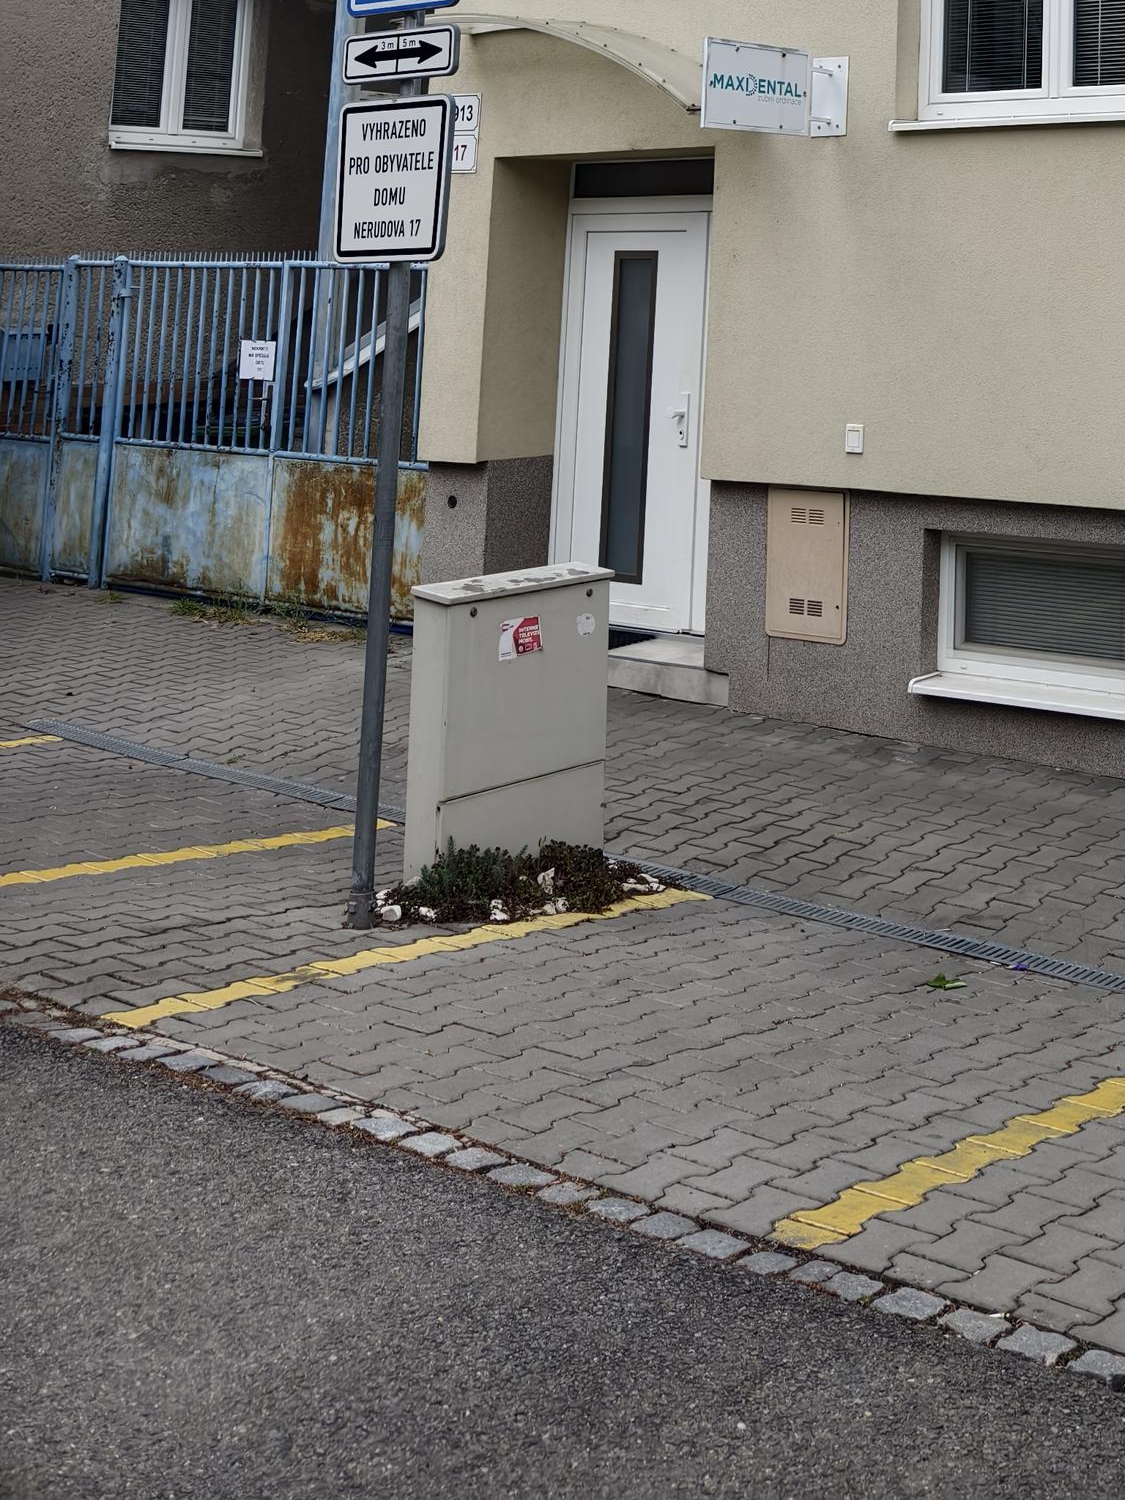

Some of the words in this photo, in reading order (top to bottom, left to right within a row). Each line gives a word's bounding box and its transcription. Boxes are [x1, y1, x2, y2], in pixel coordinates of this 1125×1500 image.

[362, 118, 427, 141] VYHRAZENO
[349, 156, 370, 175] PRO
[374, 151, 435, 173] OBYVATELE
[454, 144, 467, 161] 17
[373, 186, 406, 207] DOMU
[353, 220, 405, 239] NERUDOVA
[409, 219, 421, 237] 17
